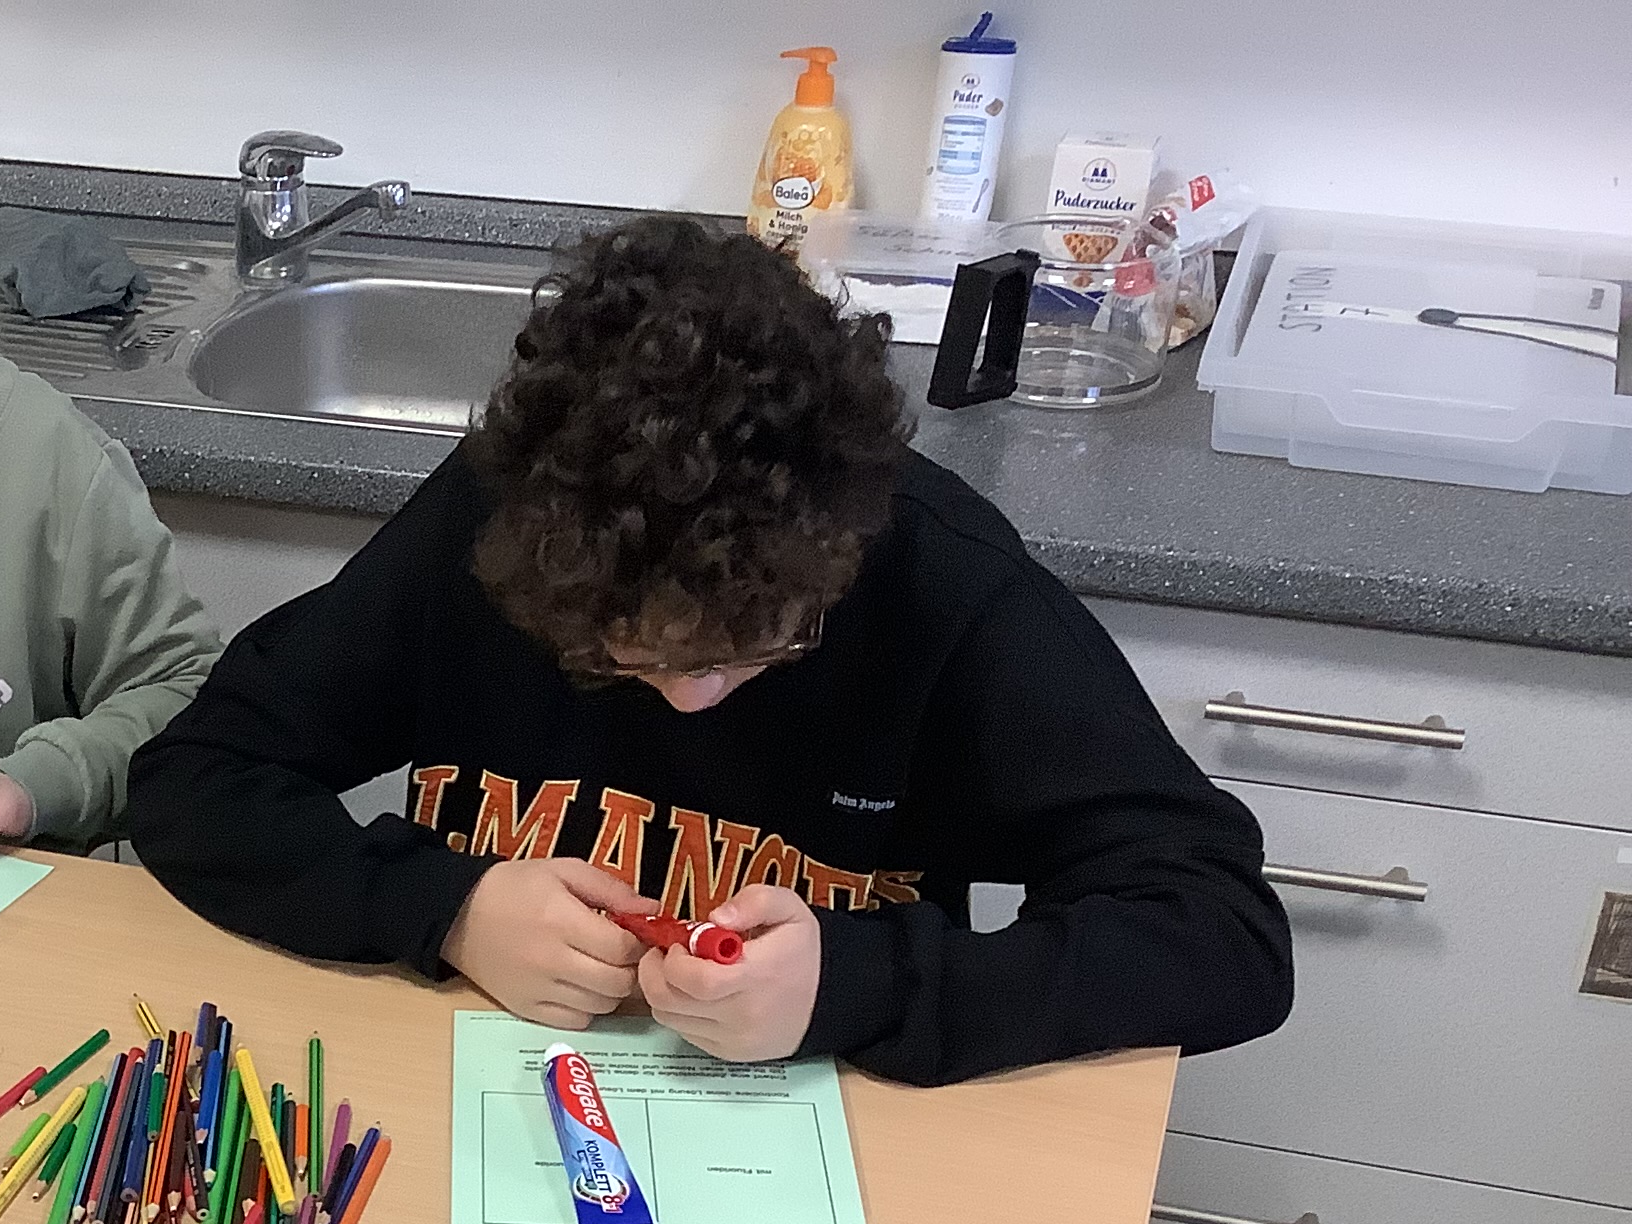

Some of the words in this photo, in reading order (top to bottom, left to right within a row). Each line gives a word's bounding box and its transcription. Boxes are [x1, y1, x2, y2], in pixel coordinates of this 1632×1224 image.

[953, 90, 983, 103] Puder
[1054, 190, 1136, 211] Puderzucker
[776, 210, 803, 221] Milch
[769, 219, 775, 228] &
[778, 221, 808, 234] Honig
[567, 1056, 604, 1128] Colgate
[584, 1140, 612, 1193] KOMPLETT
